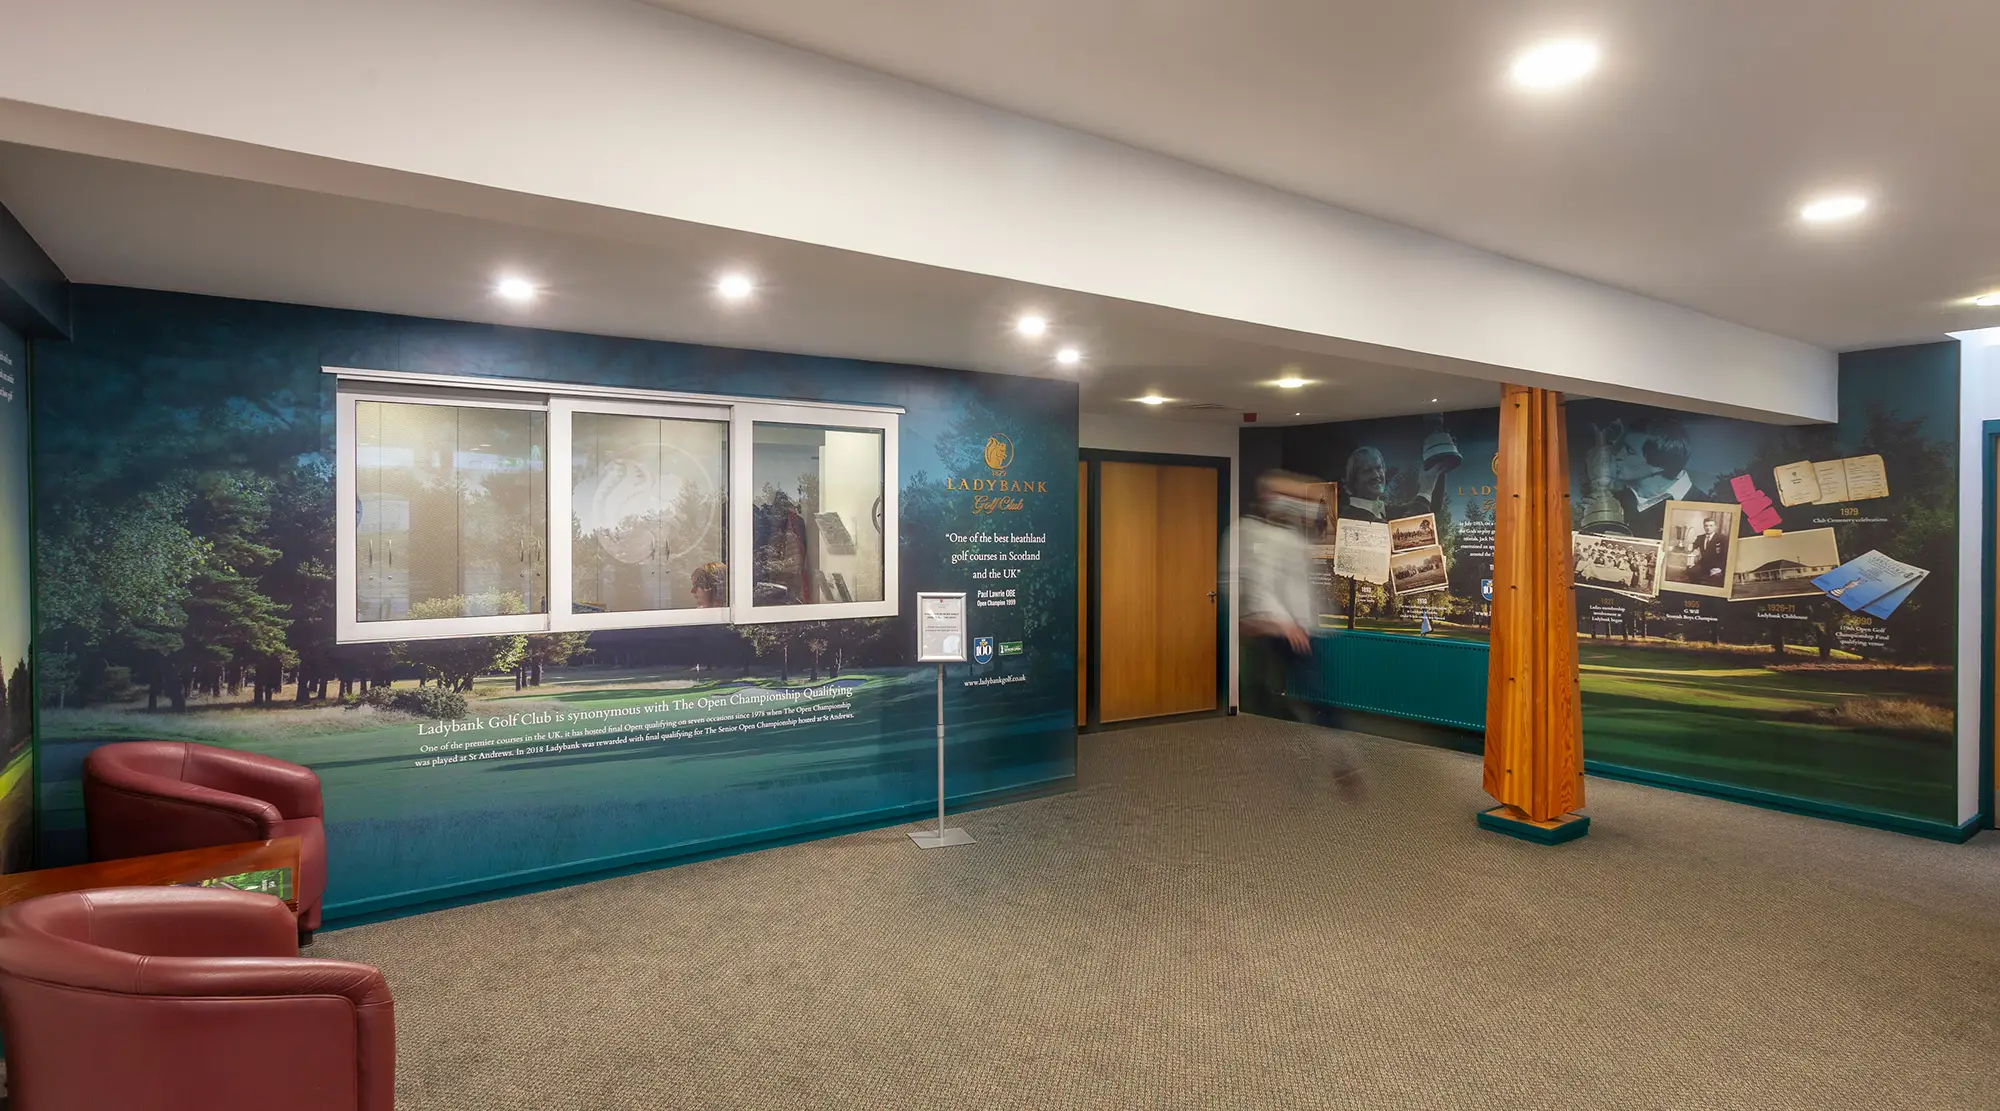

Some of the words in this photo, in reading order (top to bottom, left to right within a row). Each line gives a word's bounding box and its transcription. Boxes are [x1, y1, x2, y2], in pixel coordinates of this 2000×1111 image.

[947, 477, 1047, 493] LADYBANK
[972, 494, 1001, 515] Golf
[999, 496, 1024, 511] Club
[1840, 508, 1859, 516] 1979
[969, 532, 980, 543] of
[980, 532, 992, 543] the
[994, 532, 1009, 543] best
[1010, 532, 1046, 543] heathland
[951, 550, 969, 564] golf
[969, 553, 997, 561] courses
[999, 551, 1007, 561] in
[1009, 550, 1040, 561] Scotland
[972, 568, 987, 579] and
[988, 568, 1001, 578] the
[978, 590, 988, 598] Paul
[989, 590, 1005, 598] Lawrie
[1483, 586, 1493, 594] 10
[1768, 604, 1795, 612] 1926-71
[976, 645, 992, 656] 100
[418, 717, 484, 737] Ladybank
[489, 713, 520, 728] Golf
[521, 711, 552, 725] Club
[556, 711, 564, 722] is
[568, 706, 640, 724] synonymous
[644, 700, 669, 713] with
[672, 699, 694, 711] The
[698, 697, 727, 711] Open
[730, 689, 800, 706] Championship
[804, 685, 852, 699] Qualifying
[420, 744, 438, 753] One
[440, 742, 450, 751] of
[450, 741, 463, 749] the
[465, 738, 494, 750] premier
[496, 736, 523, 745] courses
[534, 733, 546, 741] the
[571, 729, 583, 737] has
[584, 726, 606, 735] hosted
[608, 724, 622, 733] final
[624, 724, 643, 732] Open
[645, 720, 677, 731] qualifying
[706, 714, 734, 722] occasions
[796, 706, 812, 714] Open
[813, 702, 851, 711] Championship
[432, 754, 458, 767] played
[478, 750, 514, 760] Andrews.
[516, 748, 524, 756] In
[526, 746, 544, 755] 2018
[546, 741, 580, 752] Ladybank
[596, 736, 627, 746] rewarded
[628, 734, 644, 742] with
[645, 733, 659, 741] final
[661, 730, 693, 741] qualifying
[694, 728, 703, 736] for
[718, 725, 738, 733] Senior
[738, 723, 755, 732] Open
[756, 718, 797, 728] Championship
[798, 716, 815, 724] hosted
